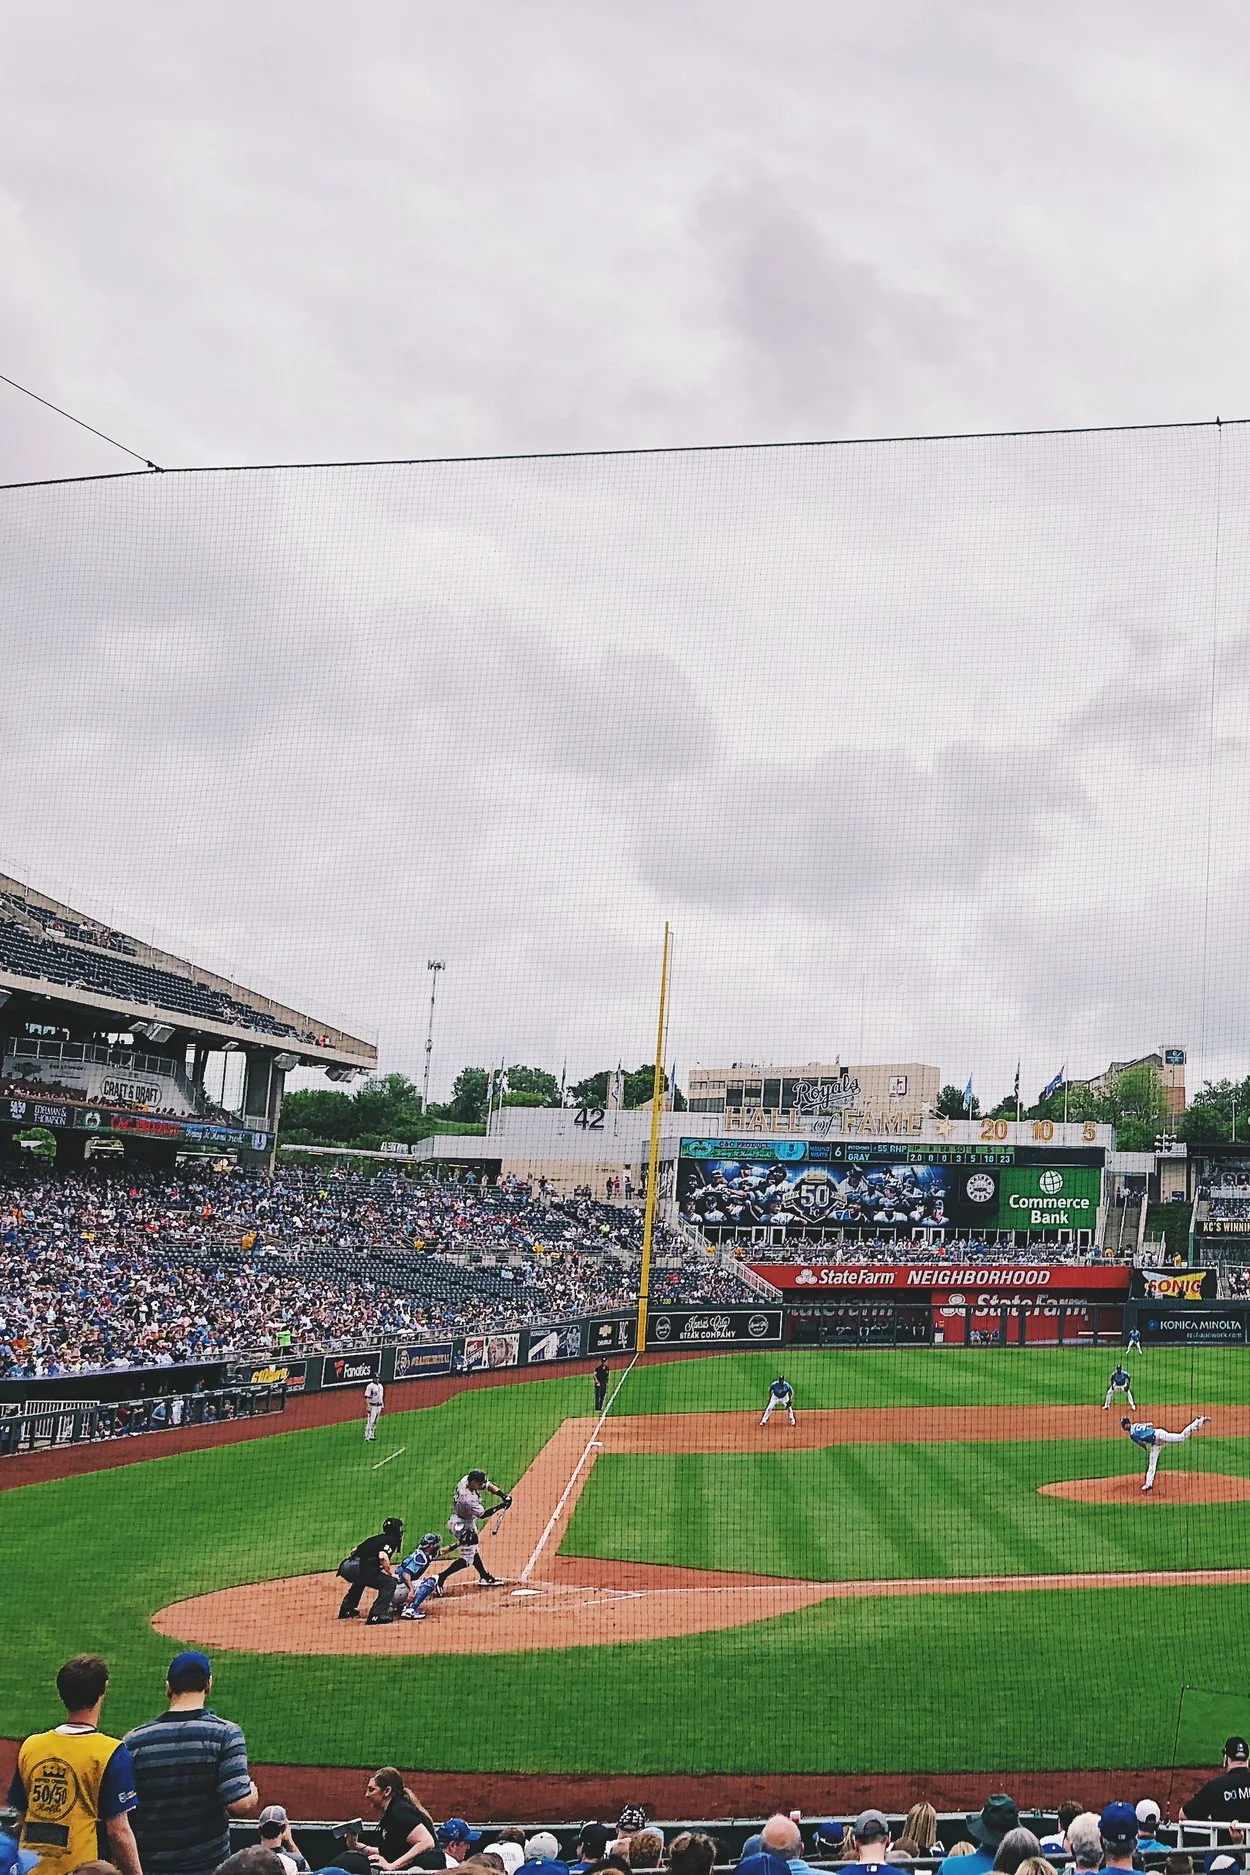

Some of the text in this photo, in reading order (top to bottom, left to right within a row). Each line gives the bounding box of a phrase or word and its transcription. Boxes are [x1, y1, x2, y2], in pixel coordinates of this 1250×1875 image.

[103, 1080, 158, 1102] CRAFT & DRAFT
[792, 1073, 861, 1111] Royals
[34, 1105, 60, 1116] EDELMAN
[34, 1112, 66, 1125] THOMPSON
[573, 1107, 605, 1130] 42
[725, 1106, 924, 1138] HALL of FAME
[980, 1118, 1097, 1142] 20 10 5
[834, 1147, 842, 1157] 6
[889, 1145, 906, 1153] RHP
[847, 1153, 870, 1161] GRAY
[910, 1154, 922, 1162] 2.0
[1000, 1155, 1010, 1163] 23
[801, 1184, 830, 1207] 50
[1008, 1194, 1090, 1209] Commerce
[1030, 1210, 1069, 1225] Bank
[1203, 1222, 1222, 1232] KC'S
[907, 1269, 1051, 1285] NEIGHBORHOOD
[1148, 1279, 1202, 1293] SONIC
[710, 1314, 731, 1332] City
[1160, 1320, 1241, 1330] KONICA MINOLTA
[680, 1330, 736, 1339] STEAK COMPANY
[343, 1362, 371, 1379] Fanatics
[33, 1785, 68, 1805] 50/50
